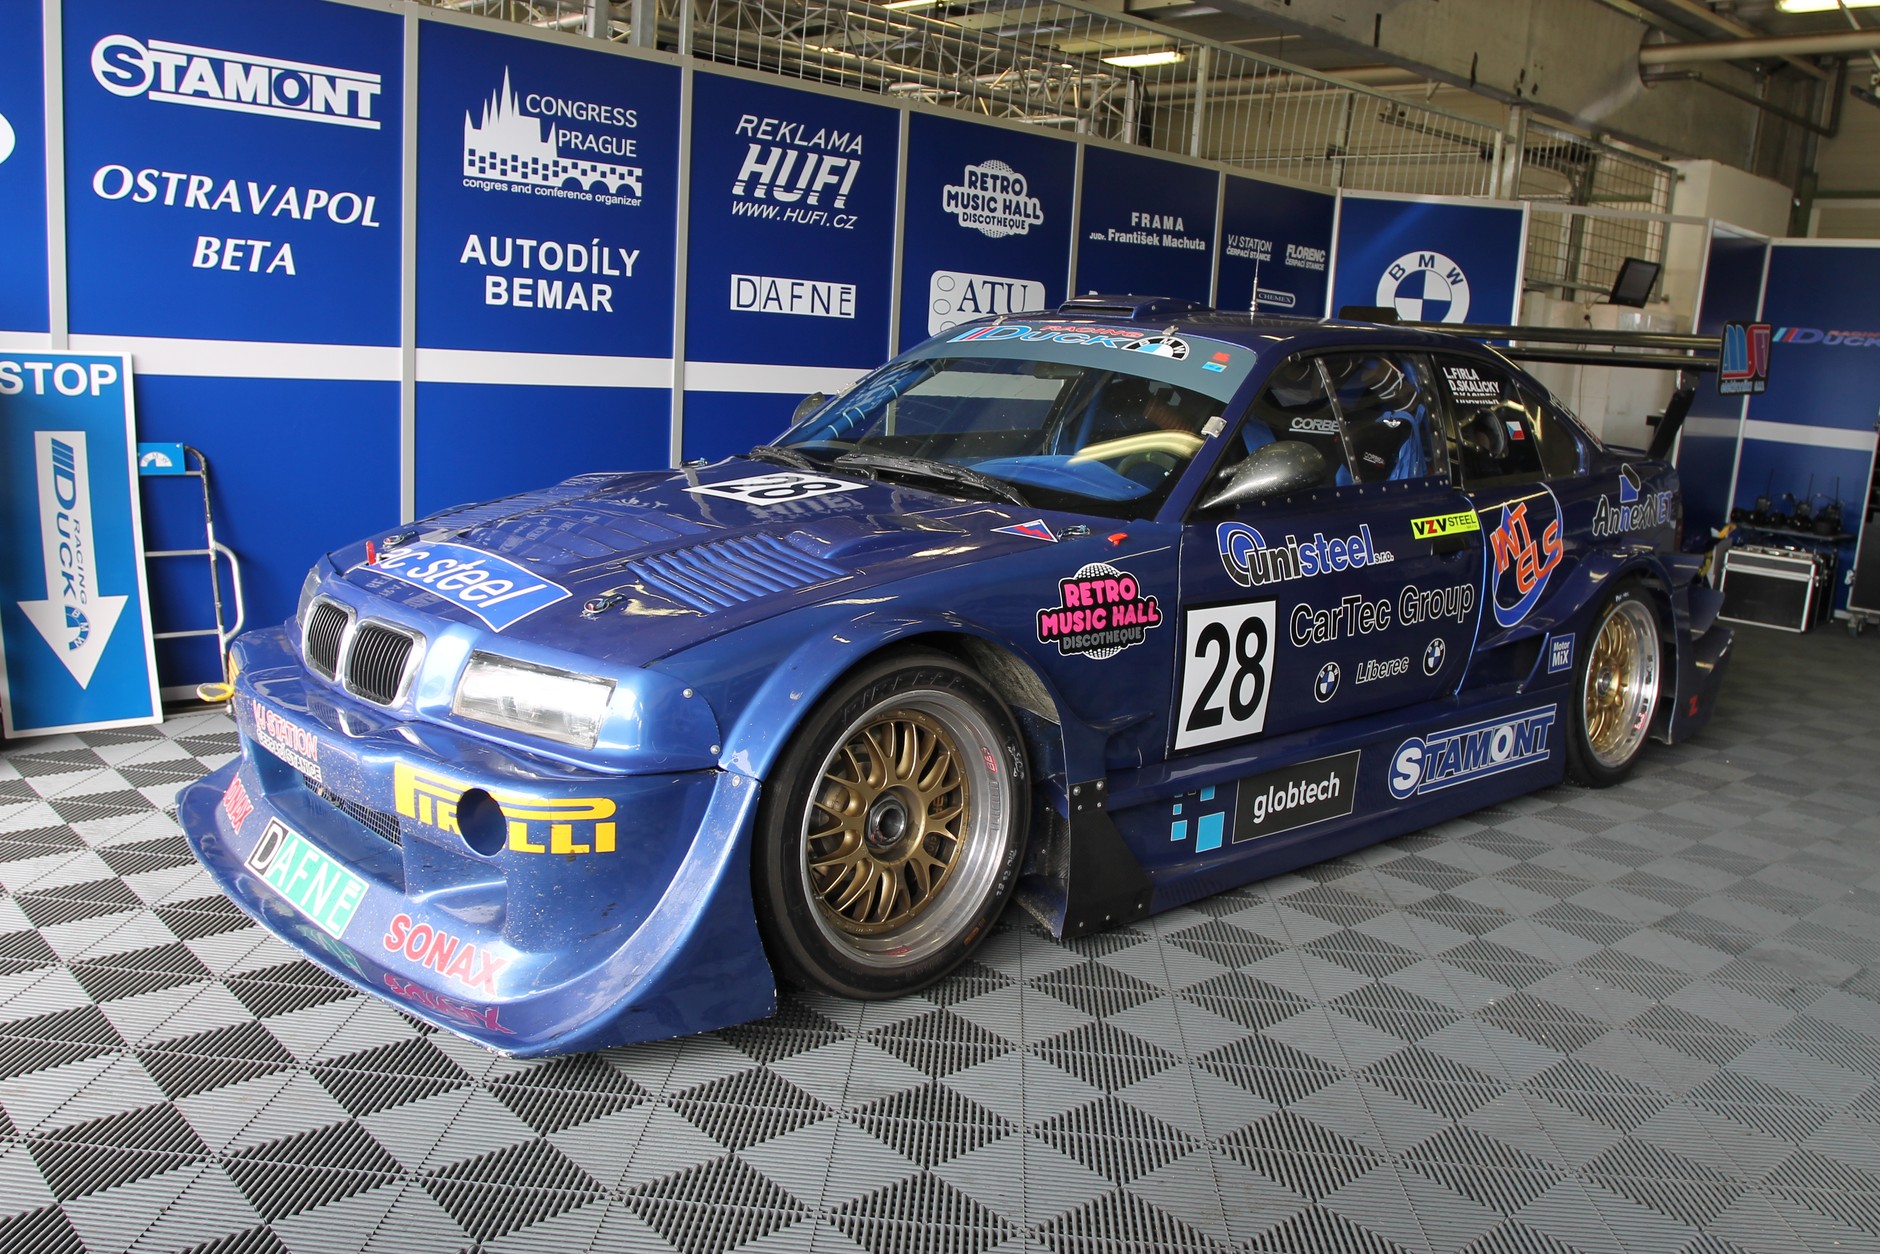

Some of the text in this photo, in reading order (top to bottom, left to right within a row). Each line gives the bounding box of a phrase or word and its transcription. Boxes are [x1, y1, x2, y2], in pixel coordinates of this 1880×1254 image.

[91, 34, 381, 120] STAMONT
[526, 94, 638, 128] CONGRESS
[558, 129, 637, 157] PRAGUE
[735, 114, 863, 155] REKLAMA
[463, 178, 642, 207] congres and conference organizer
[732, 143, 860, 209] HUFI
[968, 171, 1024, 195] RETRO
[93, 164, 380, 227] OSTRAVAPOL
[947, 189, 1041, 221] MUSIC HALL
[731, 200, 858, 229] WWW.HUFI.CZ
[962, 212, 1026, 231] DISCOTHEQUE
[1131, 211, 1184, 231] FRAMA
[192, 235, 296, 275] BETA
[460, 233, 640, 277] AUTODÍLY
[1108, 228, 1160, 246] František
[1162, 234, 1206, 250] Machuta
[1228, 234, 1273, 253] VJ STATION
[1286, 244, 1326, 262] FLORENC
[1249, 251, 1271, 262] STANICE
[1388, 253, 1464, 286] BMW
[485, 275, 613, 312] BEMAR
[736, 277, 852, 317] DAFNE
[957, 278, 1028, 315] ATU
[1258, 293, 1291, 303] CHEMEX
[968, 325, 1130, 349] DUCK
[1040, 325, 1144, 338] RACING
[1140, 338, 1186, 354] BMW
[0, 361, 117, 397] STOP
[1442, 367, 1480, 380] L.FIRLA
[1448, 379, 1500, 393] D.SKALICKY
[1291, 417, 1343, 432] CORBE
[705, 476, 843, 499] 28
[1413, 514, 1477, 535] VZV STEEL
[1592, 490, 1673, 536] AnnexNET
[53, 463, 77, 601] DUCK
[73, 518, 88, 605] RACING
[1374, 549, 1394, 564] s.r.o.
[406, 558, 548, 609] steel
[1064, 577, 1136, 608] RETRO
[70, 609, 90, 648] BMW
[1041, 601, 1159, 636] MUSIC HALL
[1289, 583, 1475, 648] CarTec Group
[1063, 626, 1142, 650] DISCOTHEQUE
[1553, 641, 1570, 652] Motor
[1185, 616, 1268, 731] 28
[1355, 656, 1410, 684] Liberec
[266, 709, 318, 762] STATION
[1388, 713, 1556, 800] STAMONT
[394, 761, 617, 856] PIRLLI
[1252, 771, 1341, 824] globtech
[249, 823, 363, 934] DAFNE
[383, 912, 509, 997] SONAX
